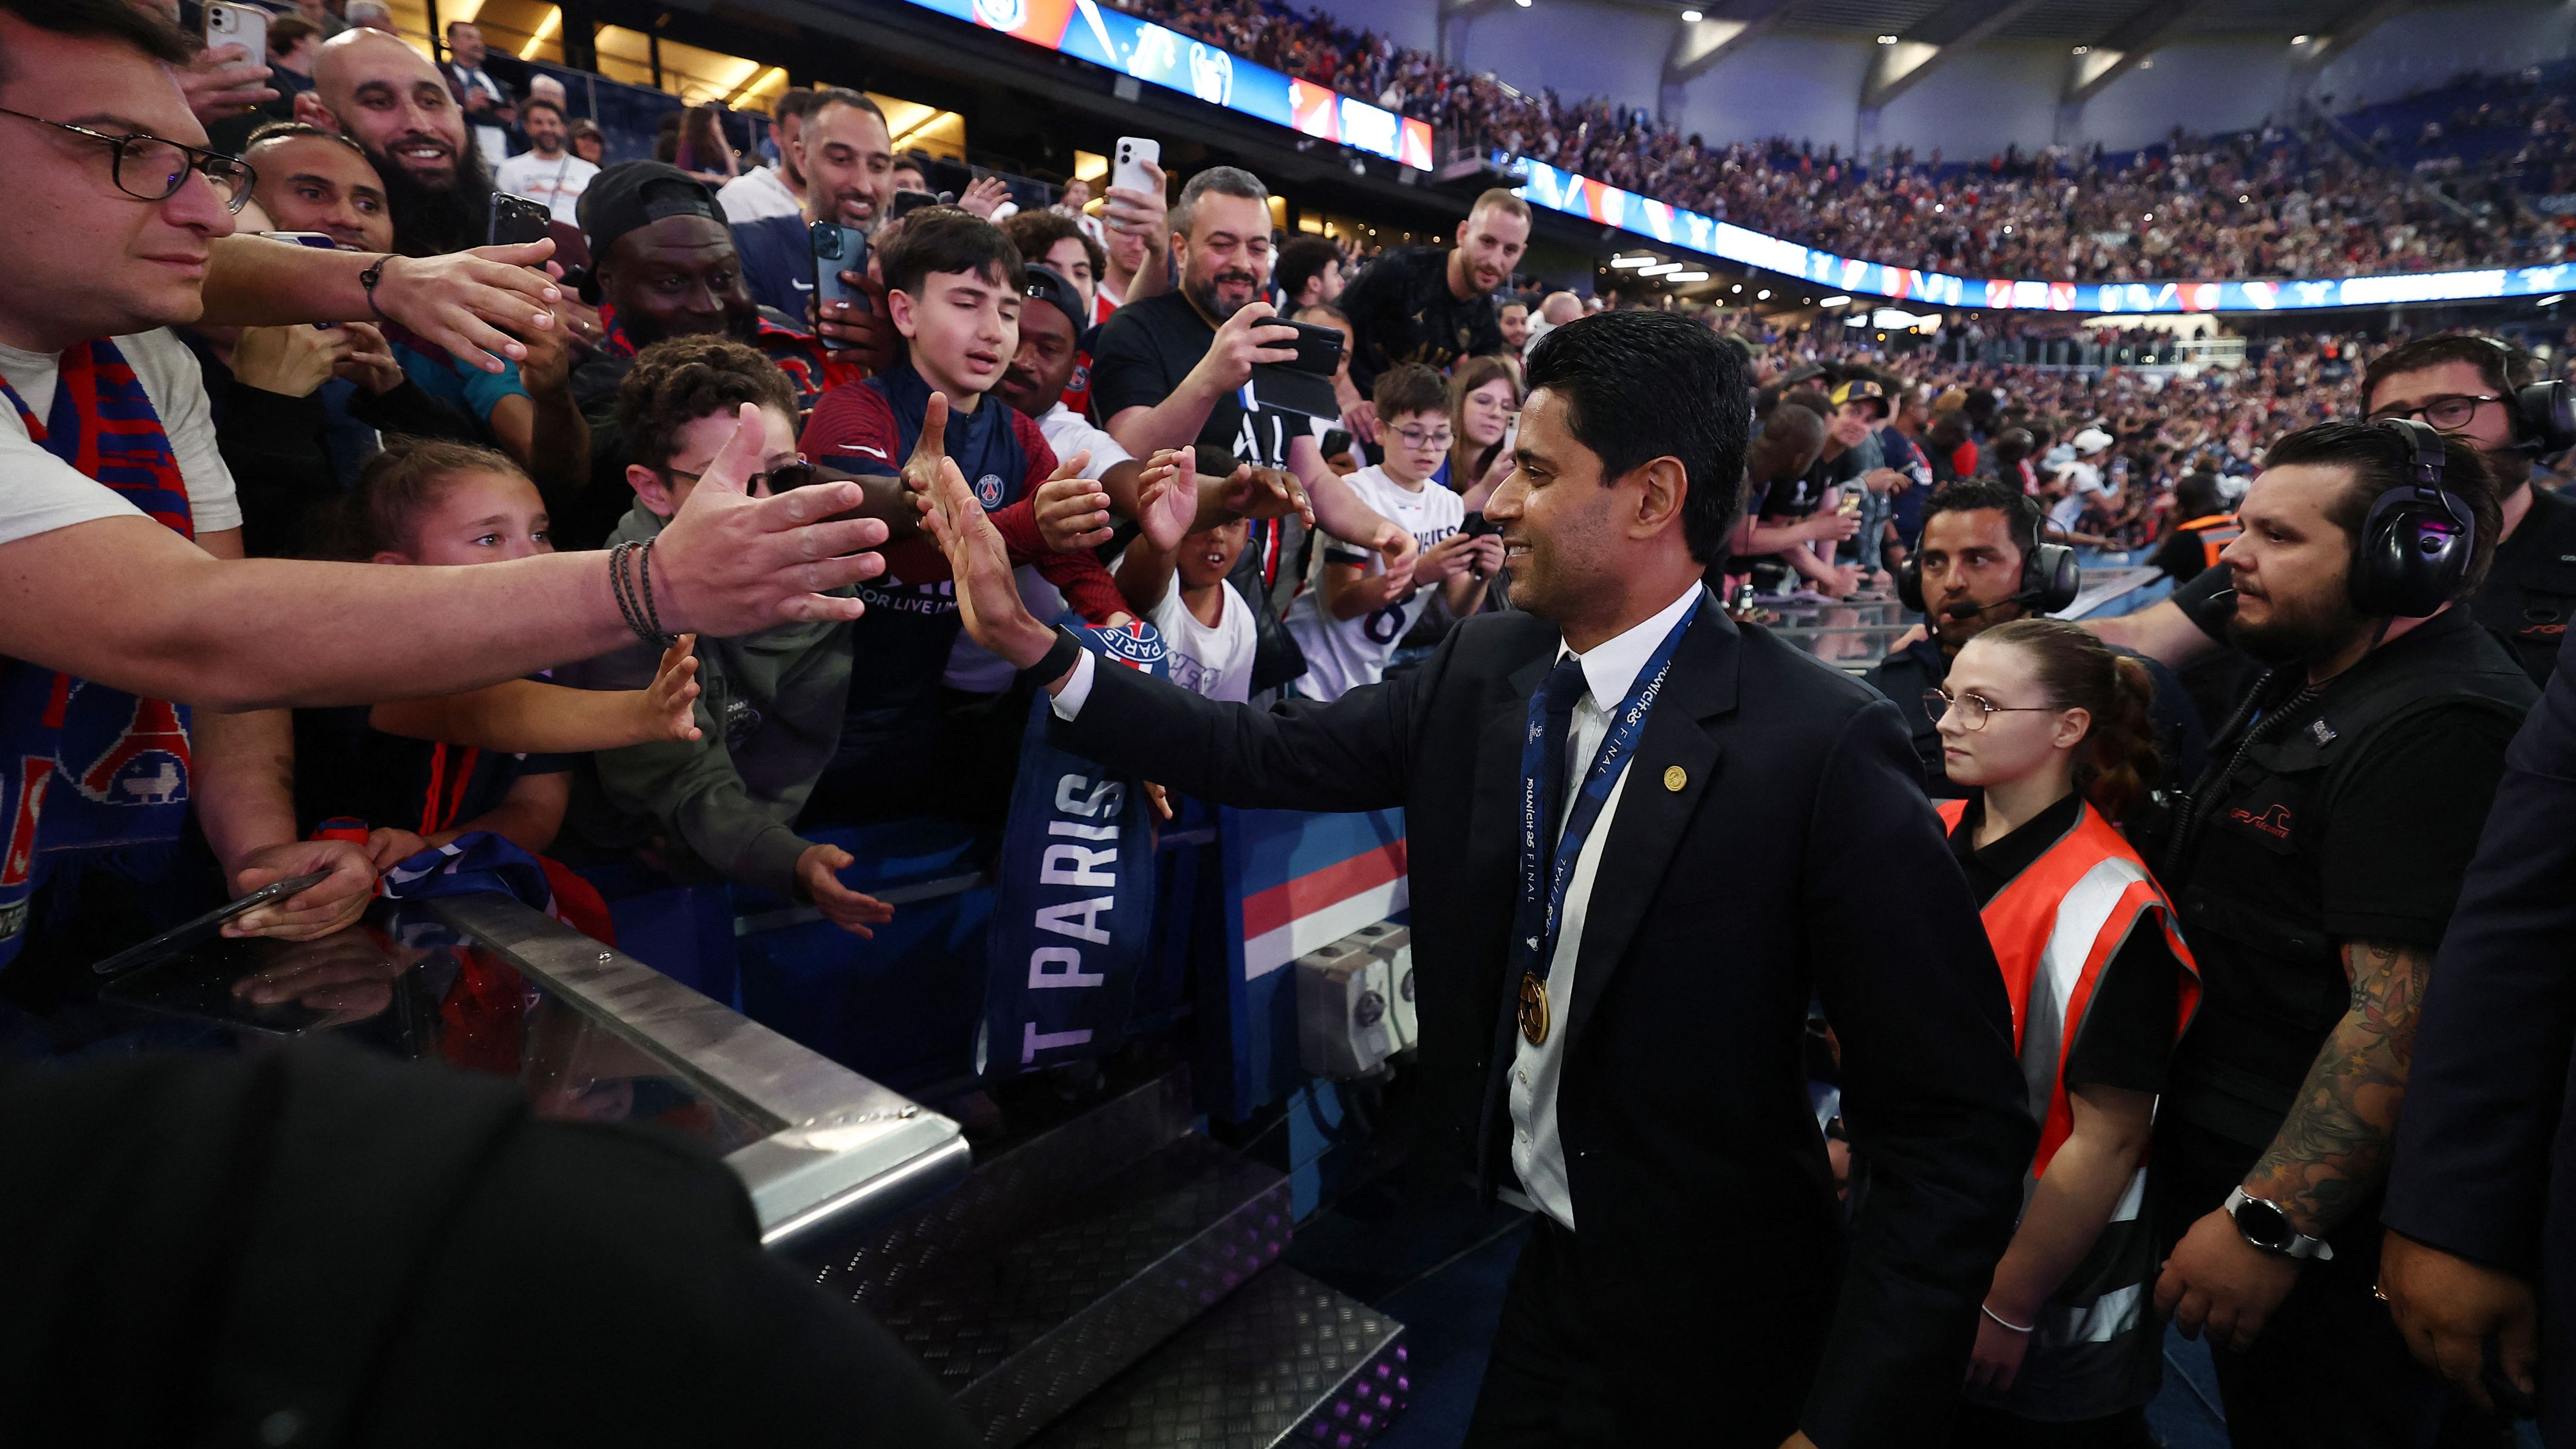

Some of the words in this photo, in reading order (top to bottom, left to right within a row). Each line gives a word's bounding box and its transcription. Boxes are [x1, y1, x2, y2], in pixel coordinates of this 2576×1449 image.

[893, 597, 934, 614] LIVE
[1103, 629, 1162, 658] PARIS
[1598, 727, 1628, 774] FINAL
[1028, 773, 1126, 989] PARIS
